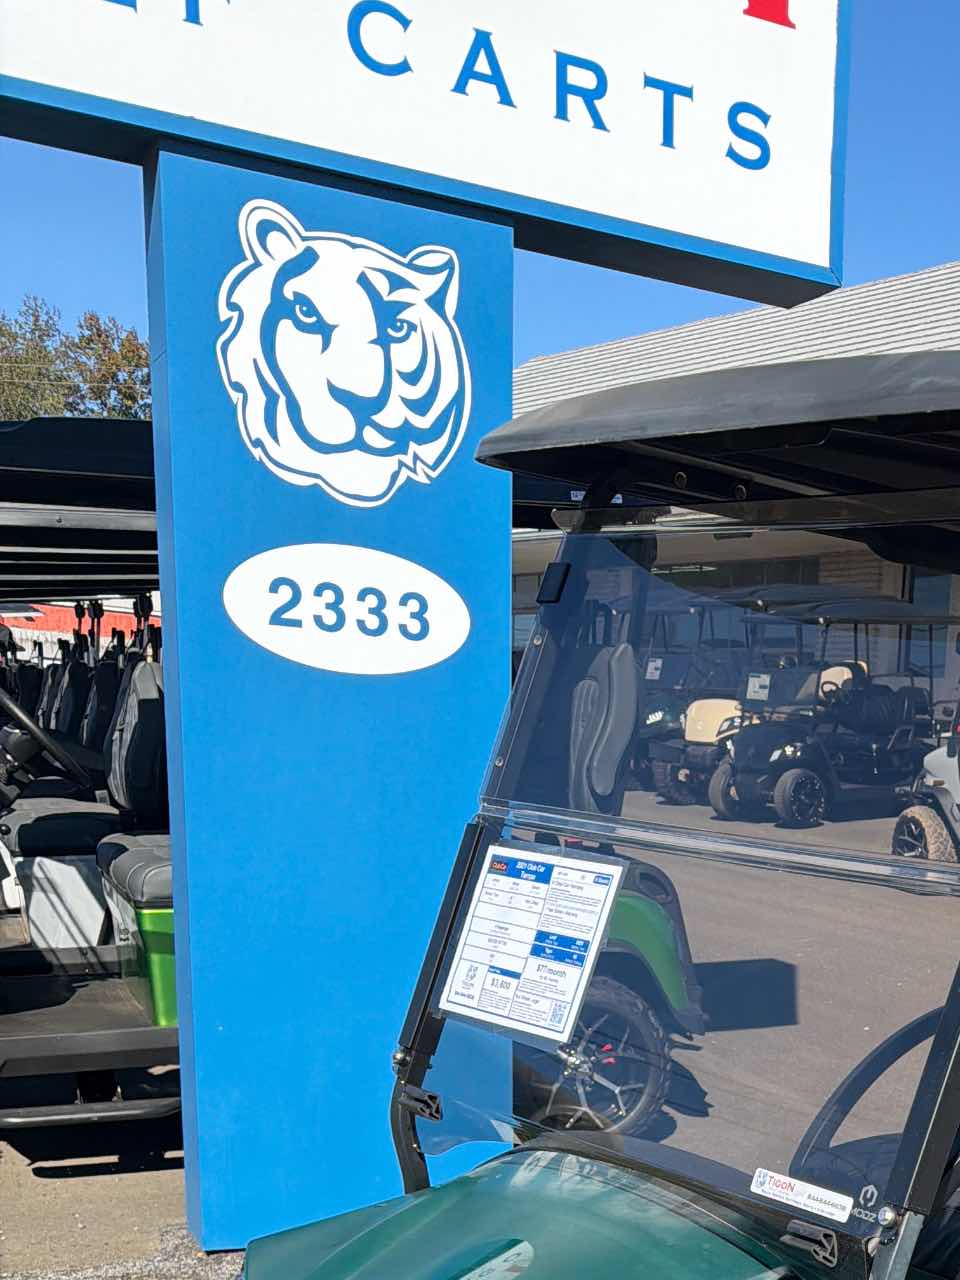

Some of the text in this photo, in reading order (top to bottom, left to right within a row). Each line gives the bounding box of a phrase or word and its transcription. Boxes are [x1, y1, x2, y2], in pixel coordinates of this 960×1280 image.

[346, 0, 773, 171] CARTS
[268, 576, 430, 642] 2333
[768, 1175, 796, 1193] TIGON
